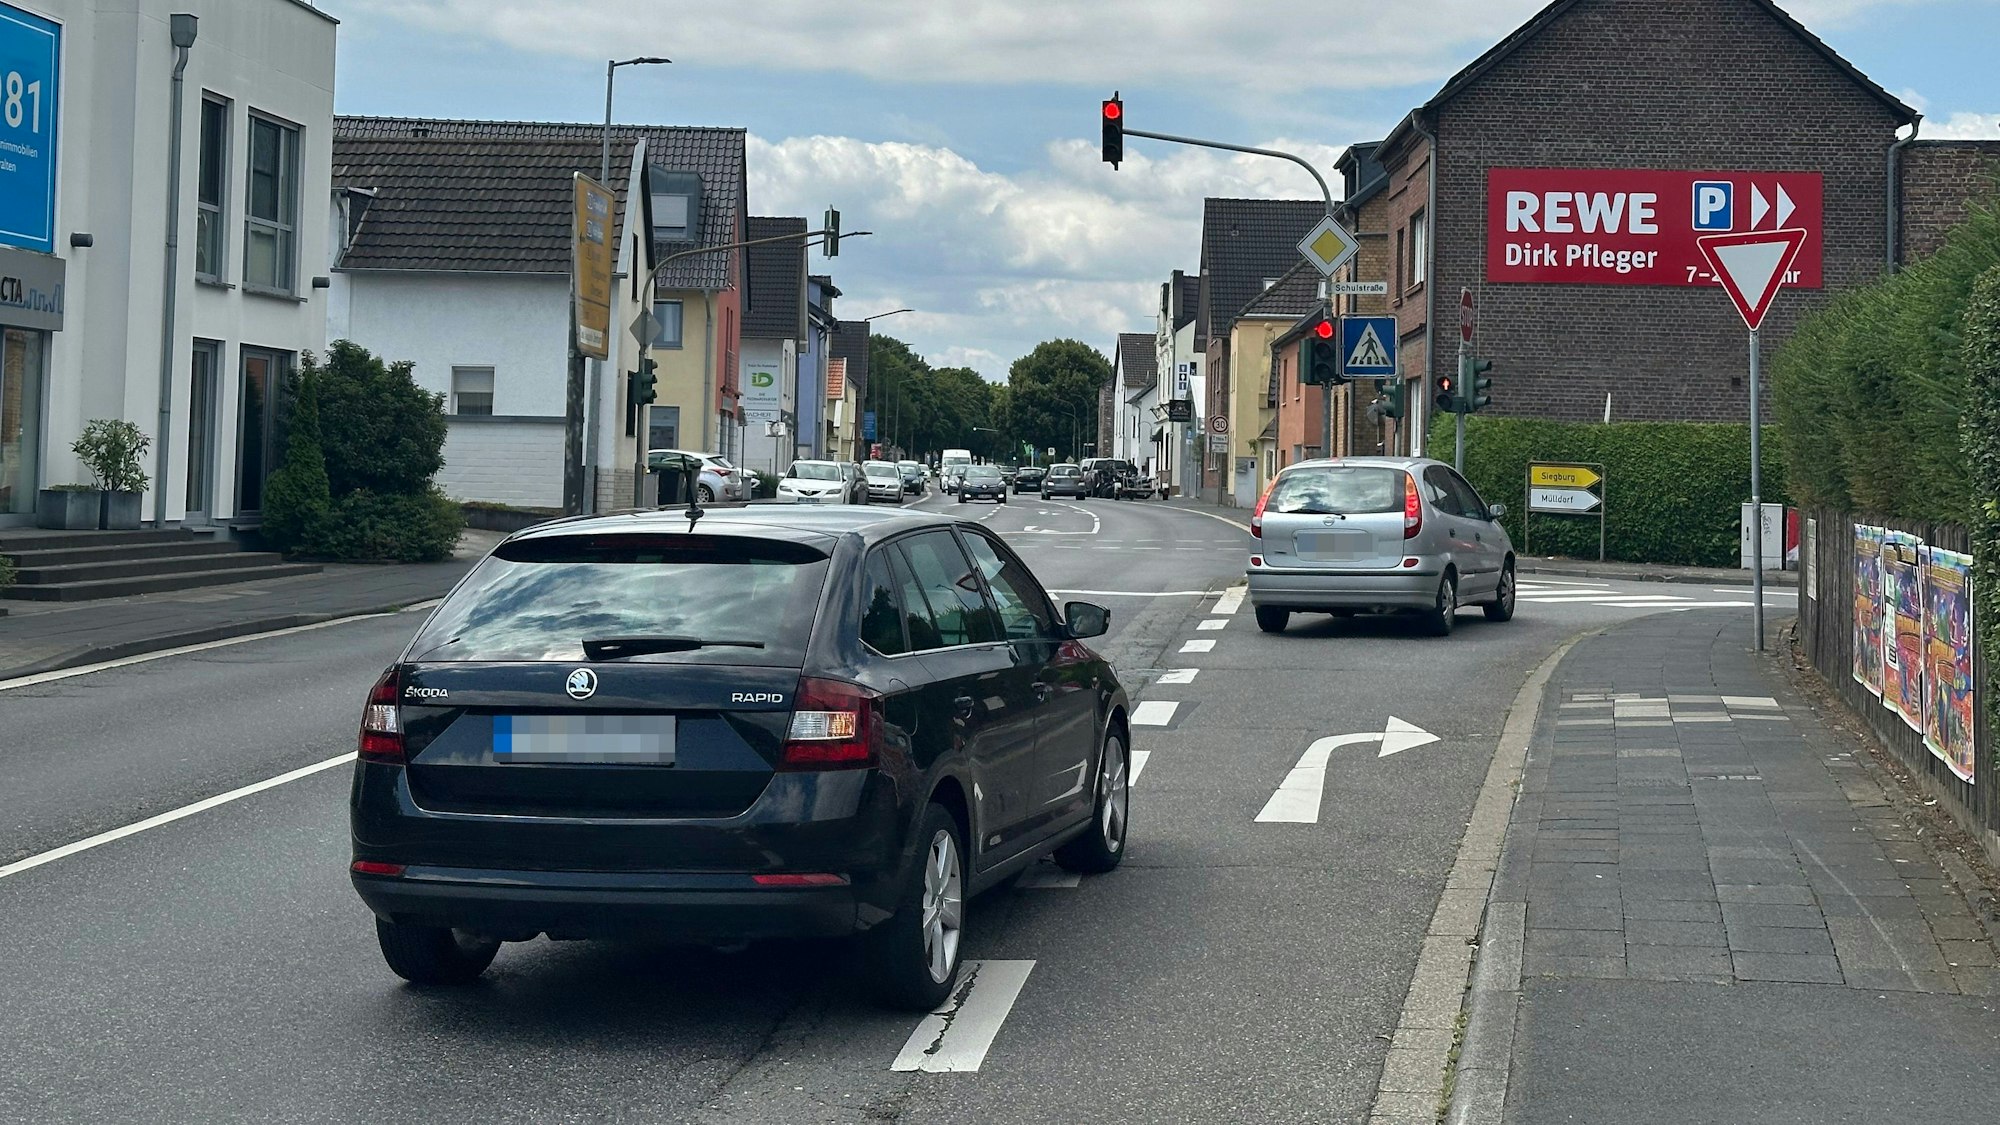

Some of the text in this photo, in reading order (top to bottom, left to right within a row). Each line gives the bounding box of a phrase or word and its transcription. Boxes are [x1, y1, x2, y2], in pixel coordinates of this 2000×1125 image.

[0, 71, 40, 133] 81
[1505, 191, 1659, 235] REWE
[1698, 187, 1726, 225] P
[1505, 243, 1658, 274] Dirk Pfleger
[0, 276, 23, 303] CTA
[1335, 283, 1384, 293] Schulstraße
[1461, 305, 1473, 328] STOP
[1215, 420, 1225, 429] 30
[1541, 471, 1576, 482] Siegburg
[1541, 494, 1574, 504] Mülldorf
[404, 685, 449, 699] ŠKODA
[730, 692, 784, 704] RAPID
